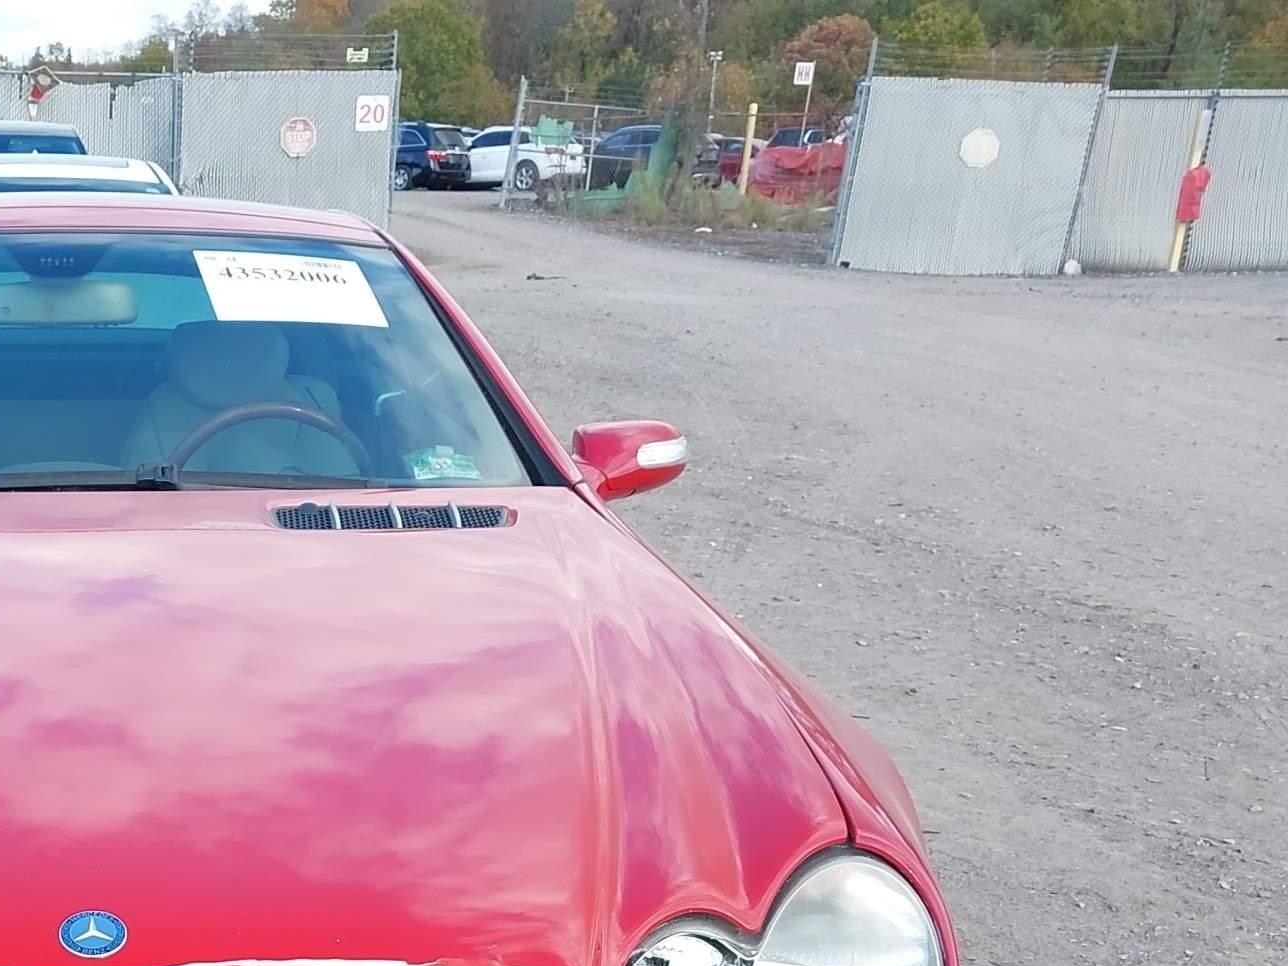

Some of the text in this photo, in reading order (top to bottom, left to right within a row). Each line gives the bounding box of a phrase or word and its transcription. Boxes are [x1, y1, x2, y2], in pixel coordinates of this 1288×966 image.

[358, 104, 386, 124] 20
[285, 130, 312, 144] STOP
[218, 265, 348, 285] 43532006
